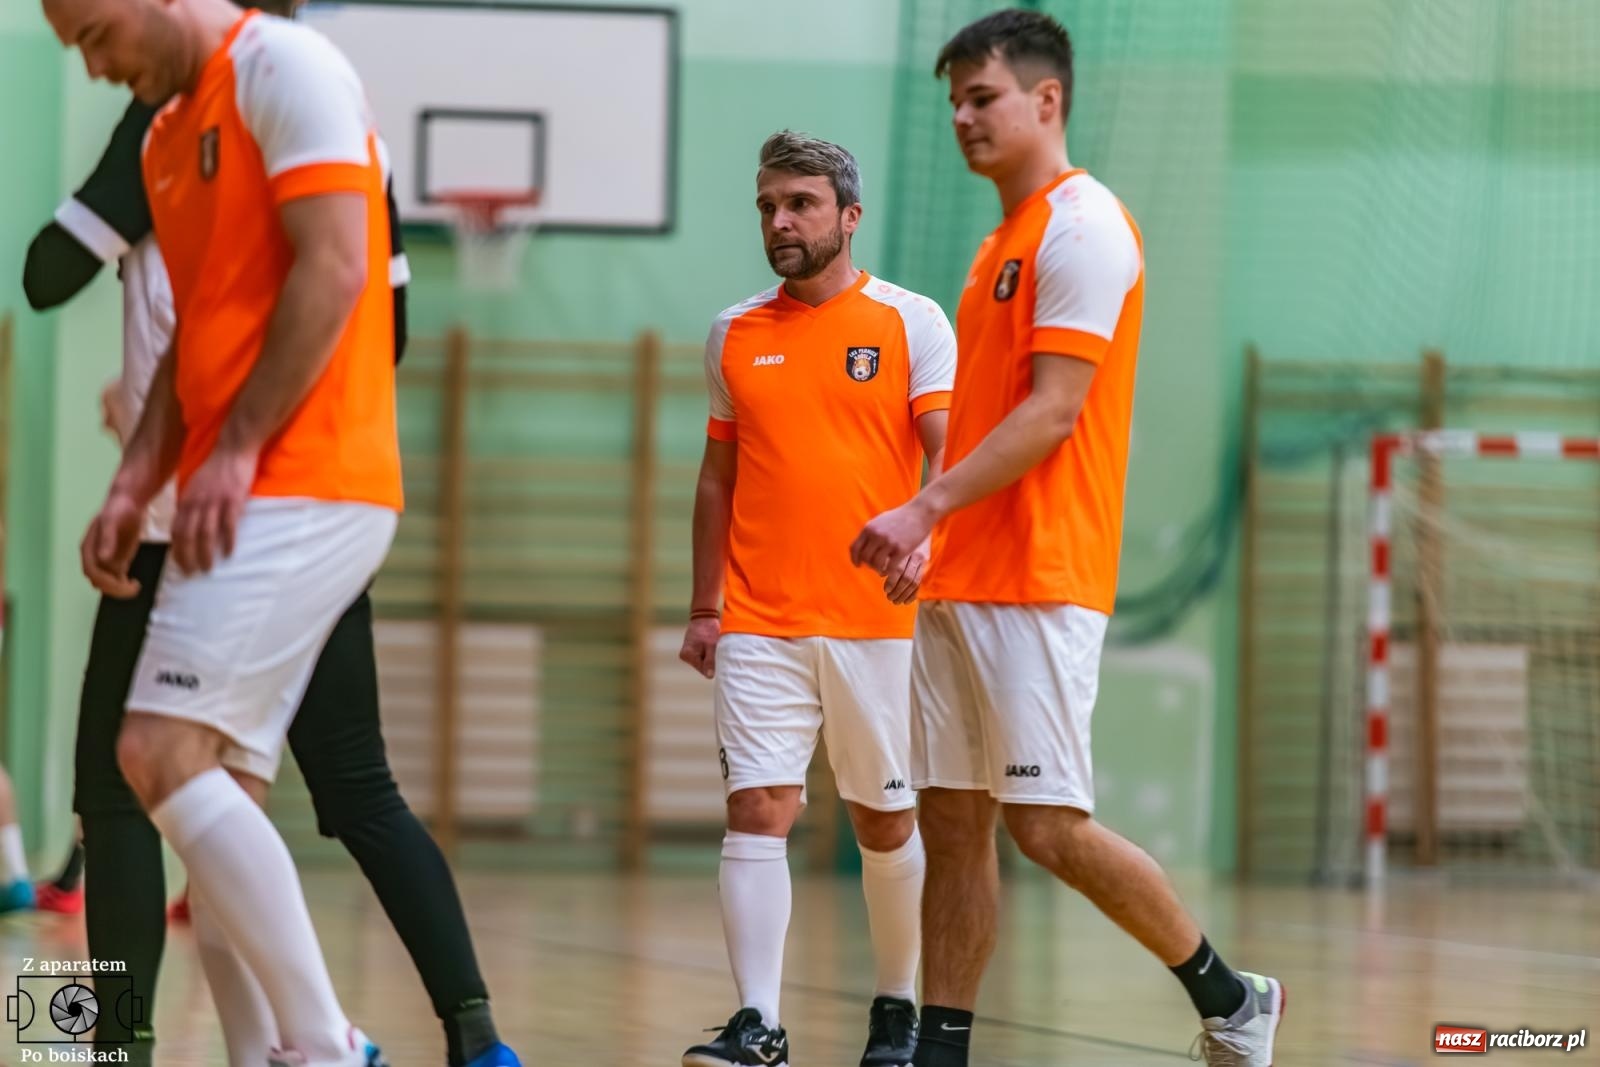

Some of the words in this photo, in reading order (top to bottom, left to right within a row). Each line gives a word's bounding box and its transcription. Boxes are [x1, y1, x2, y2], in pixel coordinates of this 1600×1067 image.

[753, 354, 785, 366] JAKO
[1005, 764, 1041, 777] JAKO
[883, 779, 905, 790] JAK
